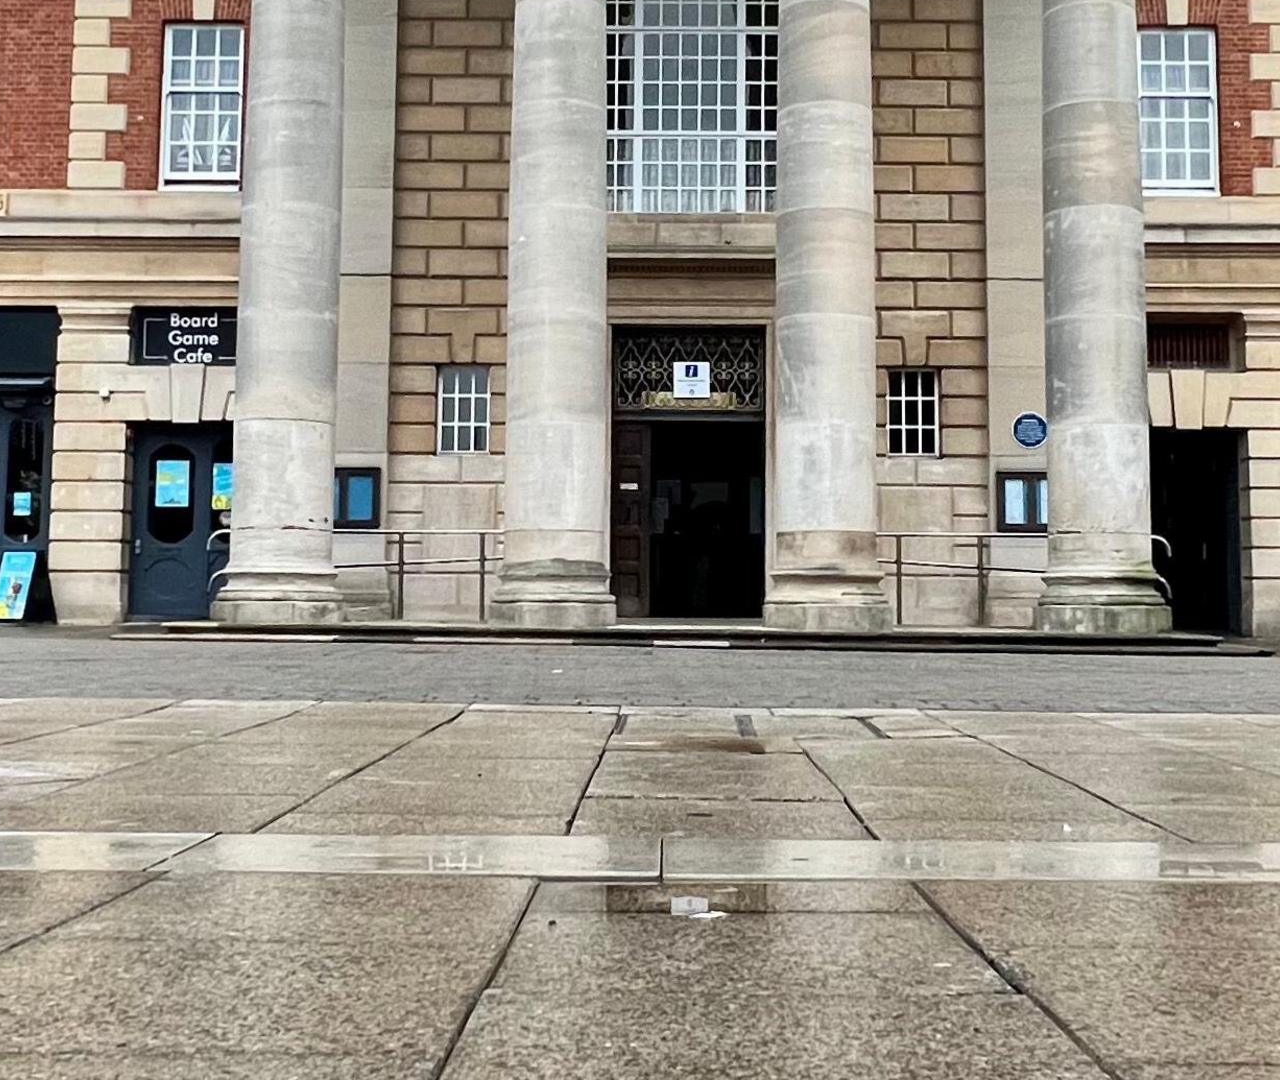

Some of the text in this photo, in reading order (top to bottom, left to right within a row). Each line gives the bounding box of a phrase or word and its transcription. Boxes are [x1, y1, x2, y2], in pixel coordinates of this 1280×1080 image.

[169, 313, 218, 328] Board
[168, 331, 219, 346] Game
[173, 348, 213, 364] Cafe
